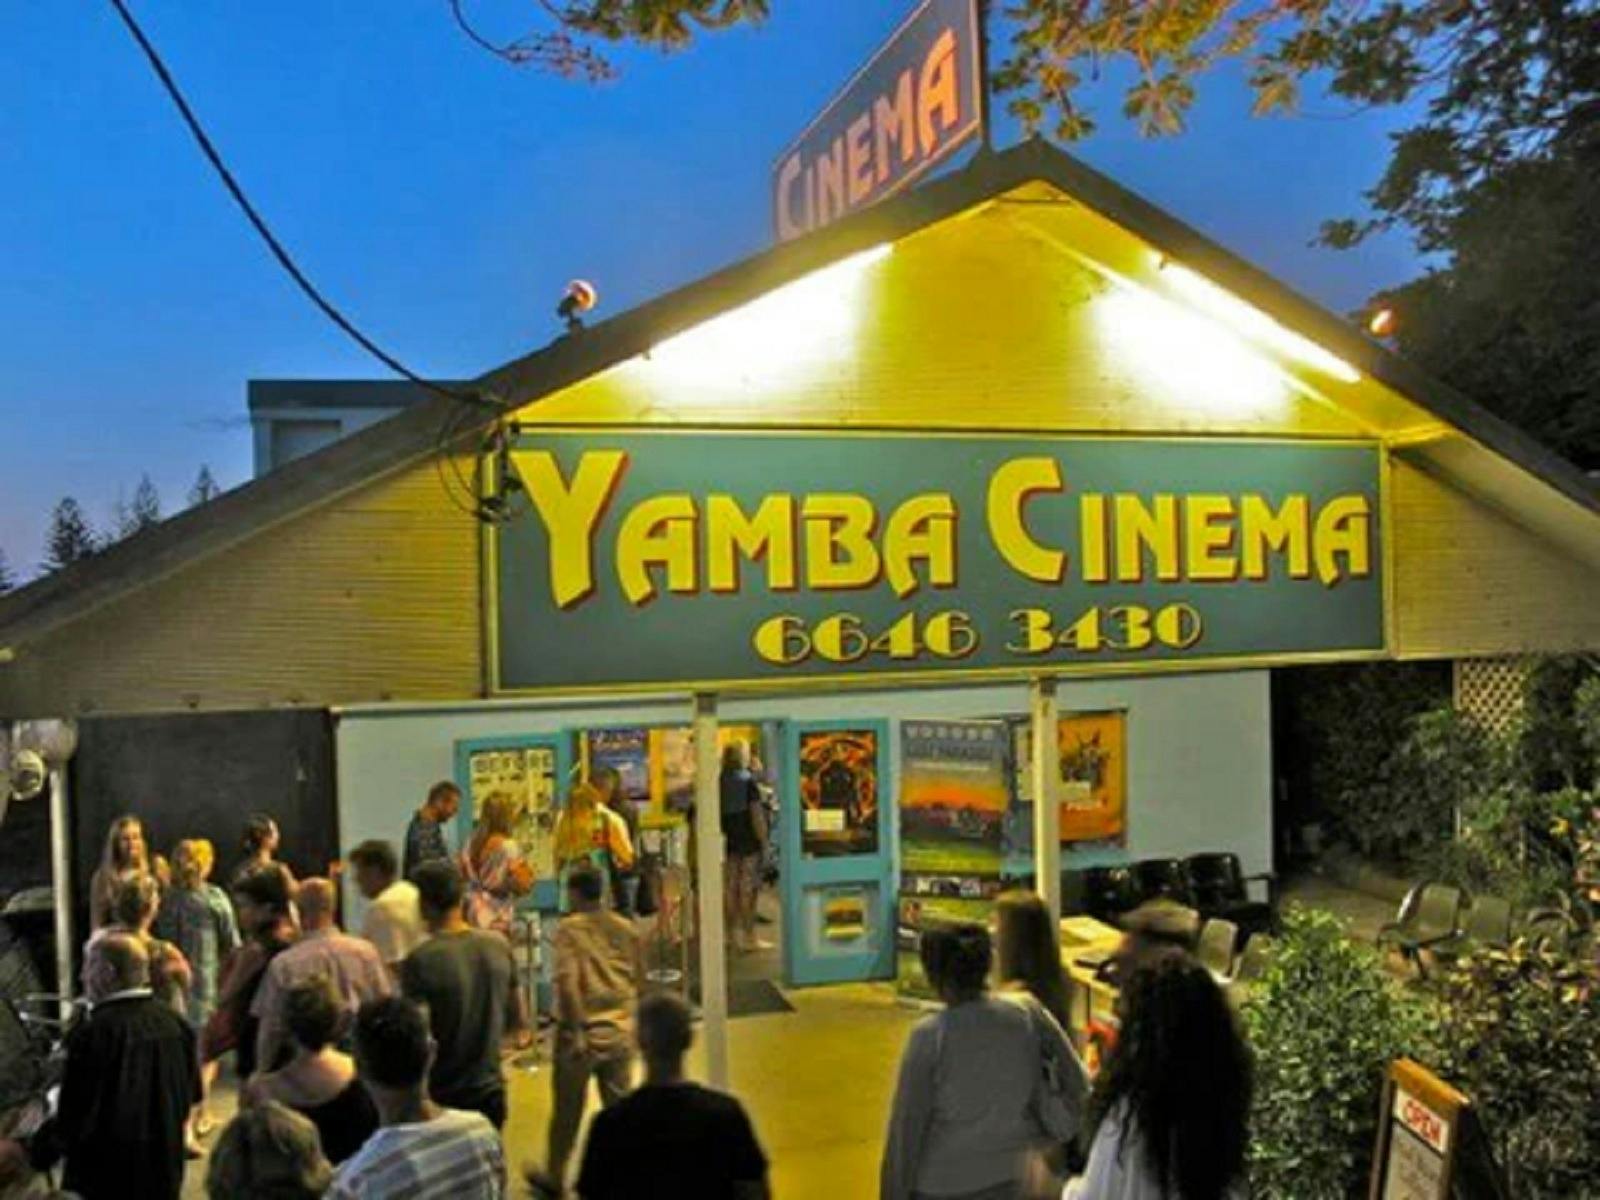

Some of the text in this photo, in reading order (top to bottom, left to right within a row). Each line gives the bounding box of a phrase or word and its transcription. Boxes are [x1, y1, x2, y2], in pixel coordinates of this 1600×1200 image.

[776, 26, 959, 243] CINEMA
[509, 449, 1370, 607] YAMBA CINEMA
[753, 602, 1203, 665] 6646 3430
[1402, 1098, 1441, 1143] OPEN
